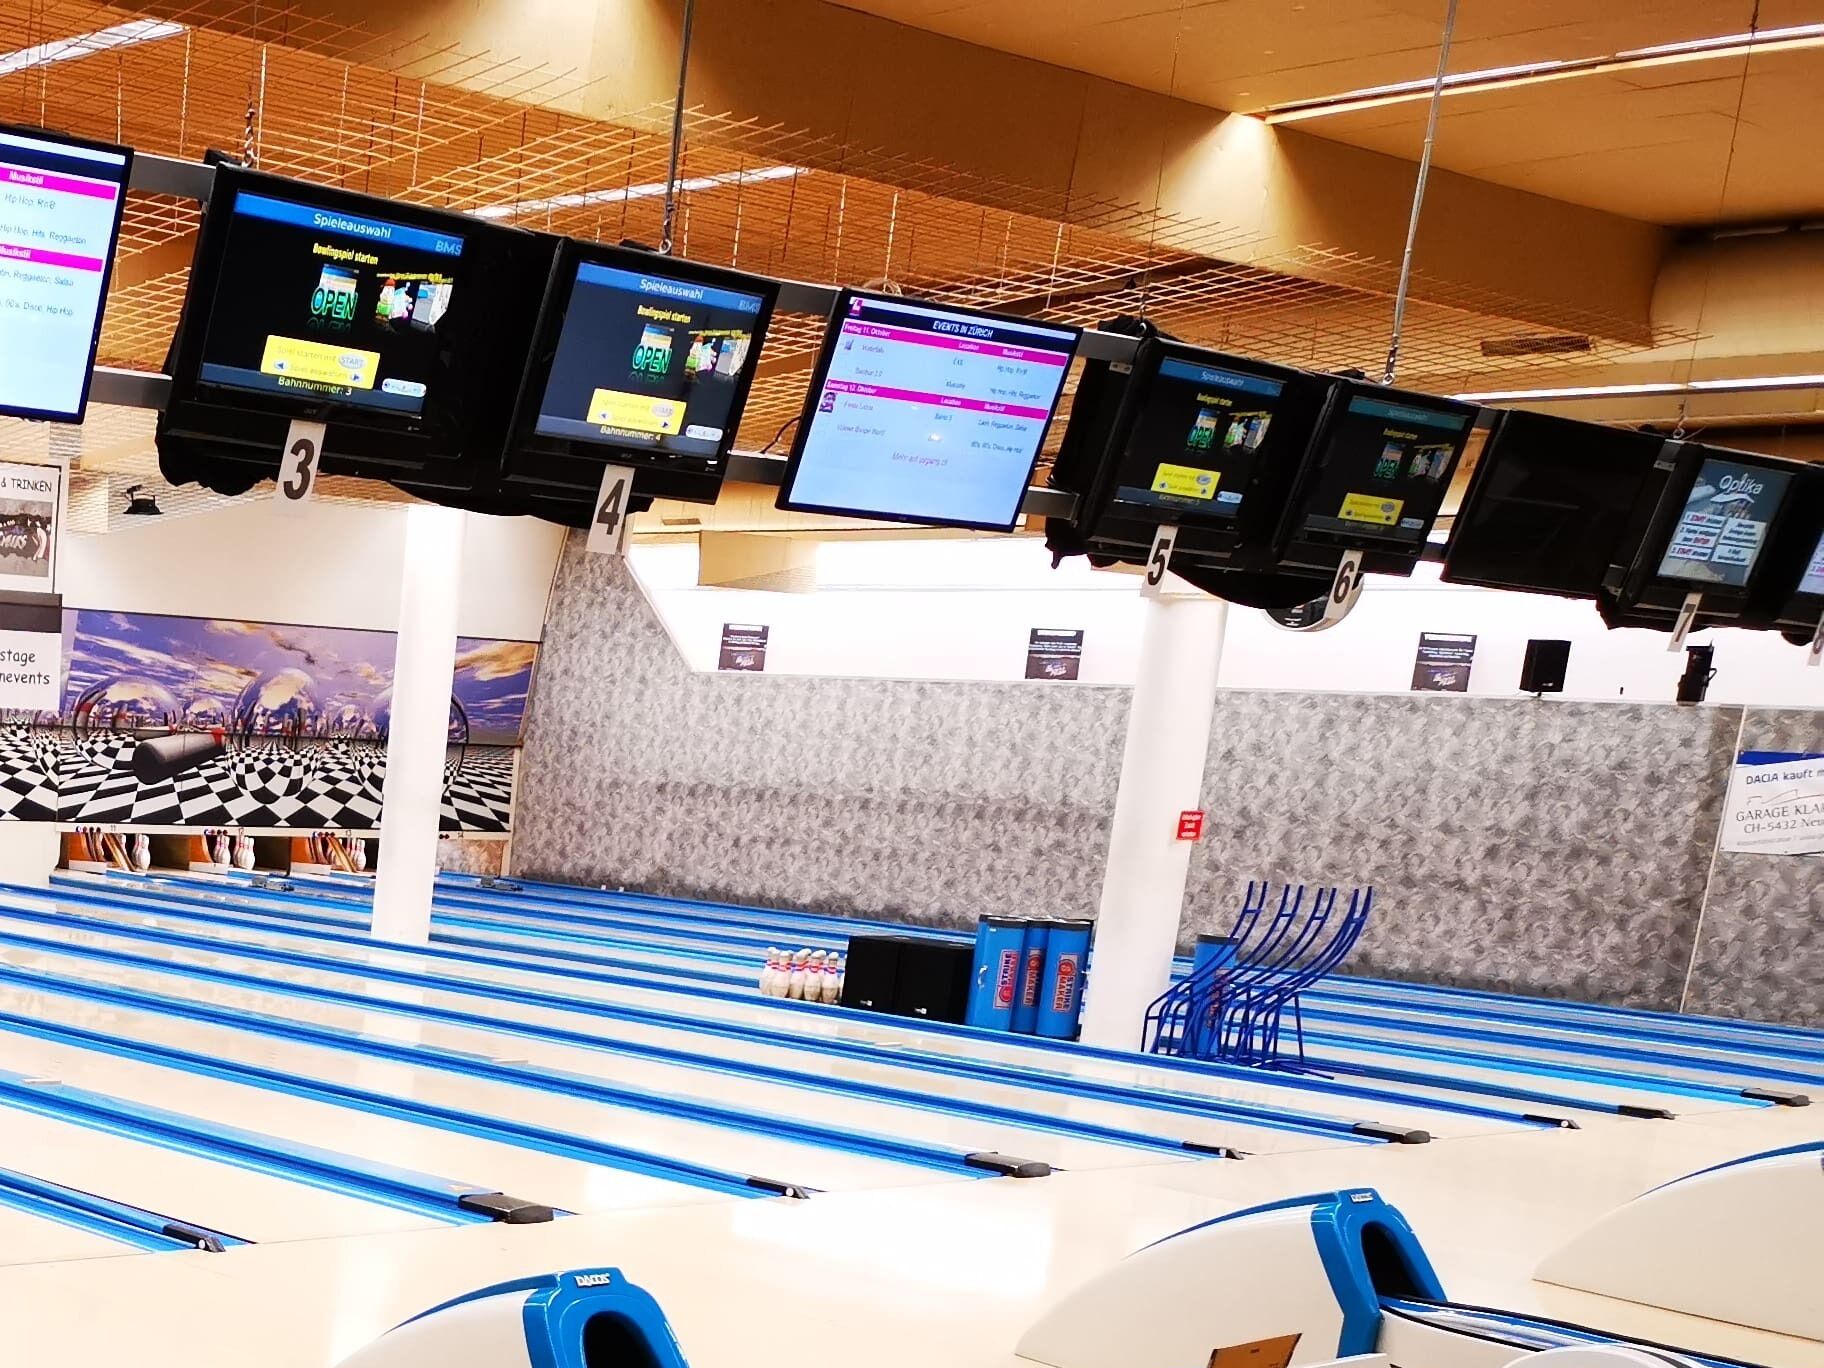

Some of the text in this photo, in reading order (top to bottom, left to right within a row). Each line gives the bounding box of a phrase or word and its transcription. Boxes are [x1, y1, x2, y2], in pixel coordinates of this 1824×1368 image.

[313, 213, 392, 239] Spieleauswahl
[355, 252, 378, 265] starten
[435, 240, 463, 257] BMS
[639, 278, 705, 300] Spieleauswahl
[310, 285, 359, 322] OPEN
[632, 343, 672, 375] OPEN
[278, 376, 353, 396] Bahnnummer: 3
[283, 438, 315, 500] 3
[11, 477, 52, 493] TRINKEN
[1719, 473, 1764, 495] Optika
[596, 478, 625, 536] 4
[1147, 538, 1171, 586] 5
[1333, 560, 1355, 604] 6
[1675, 603, 1697, 643] 7
[1746, 769, 1813, 785] DACIA kauft
[1736, 803, 1824, 822] GARAGE KLA
[1744, 820, 1797, 834] CH-5432
[575, 1273, 611, 1287] DACOS
